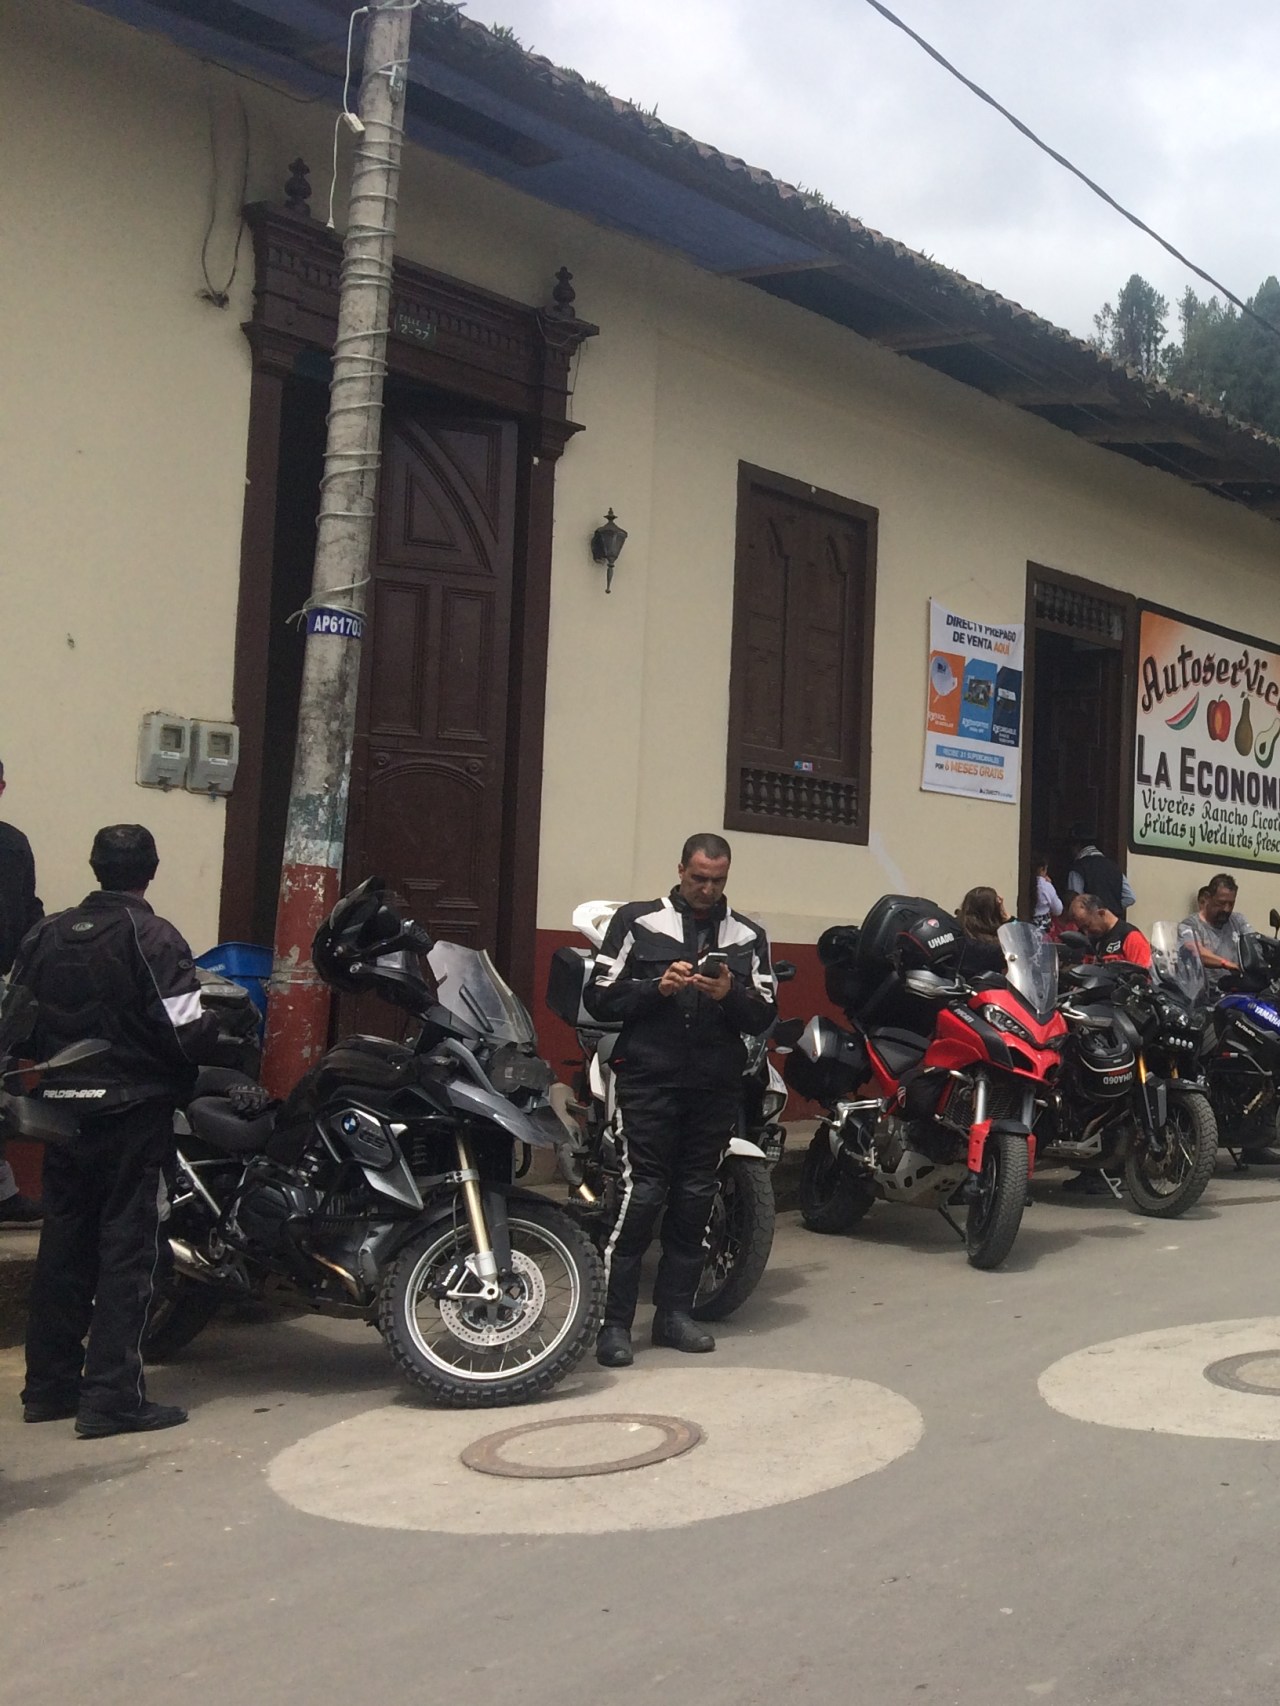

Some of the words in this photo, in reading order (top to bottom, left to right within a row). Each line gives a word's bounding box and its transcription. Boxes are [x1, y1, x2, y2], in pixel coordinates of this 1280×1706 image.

[952, 631, 965, 644] DE
[967, 634, 992, 651] VENTA
[950, 761, 978, 776] MESES
[979, 766, 1004, 780] GRATIS
[1202, 800, 1248, 827] Rancho
